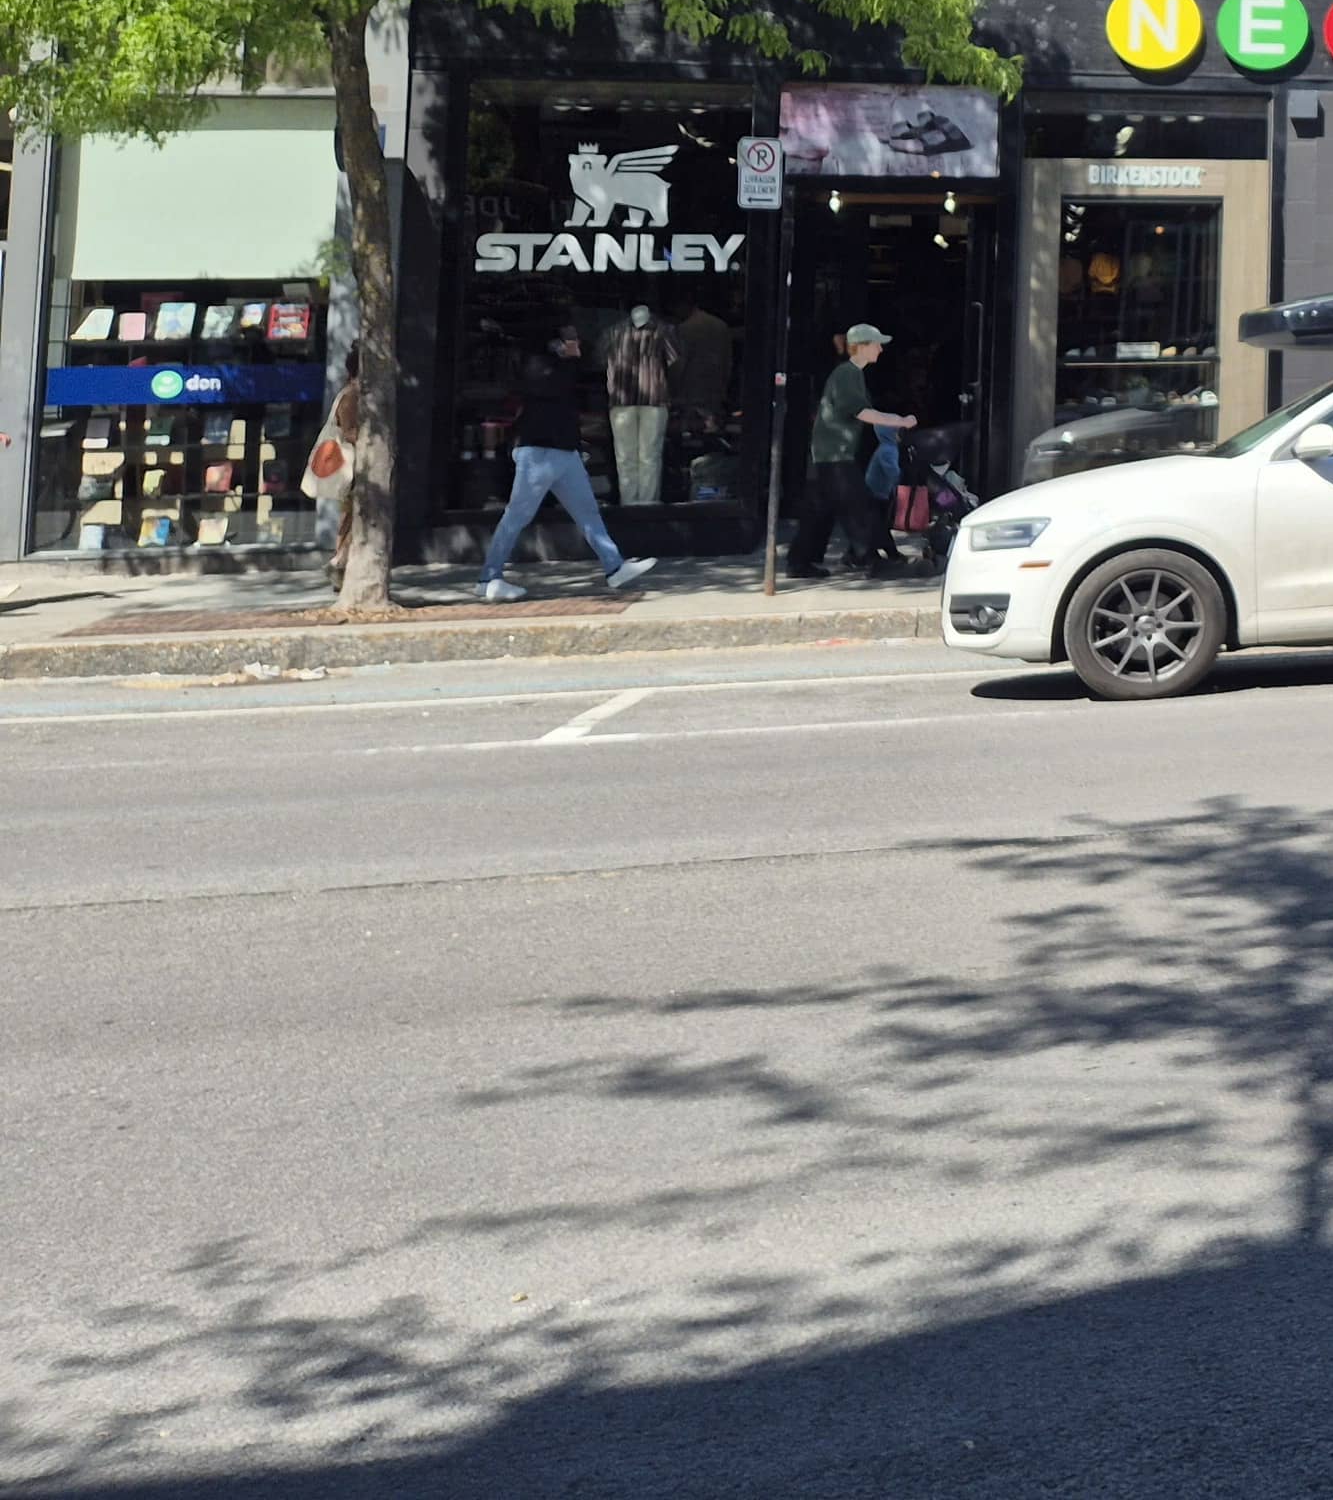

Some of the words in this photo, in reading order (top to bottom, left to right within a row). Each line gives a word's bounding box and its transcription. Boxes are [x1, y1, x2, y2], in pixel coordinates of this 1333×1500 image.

[1087, 163, 1203, 189] BIRKENSTOCK
[474, 232, 746, 273] STANLEY
[185, 373, 222, 391] don
